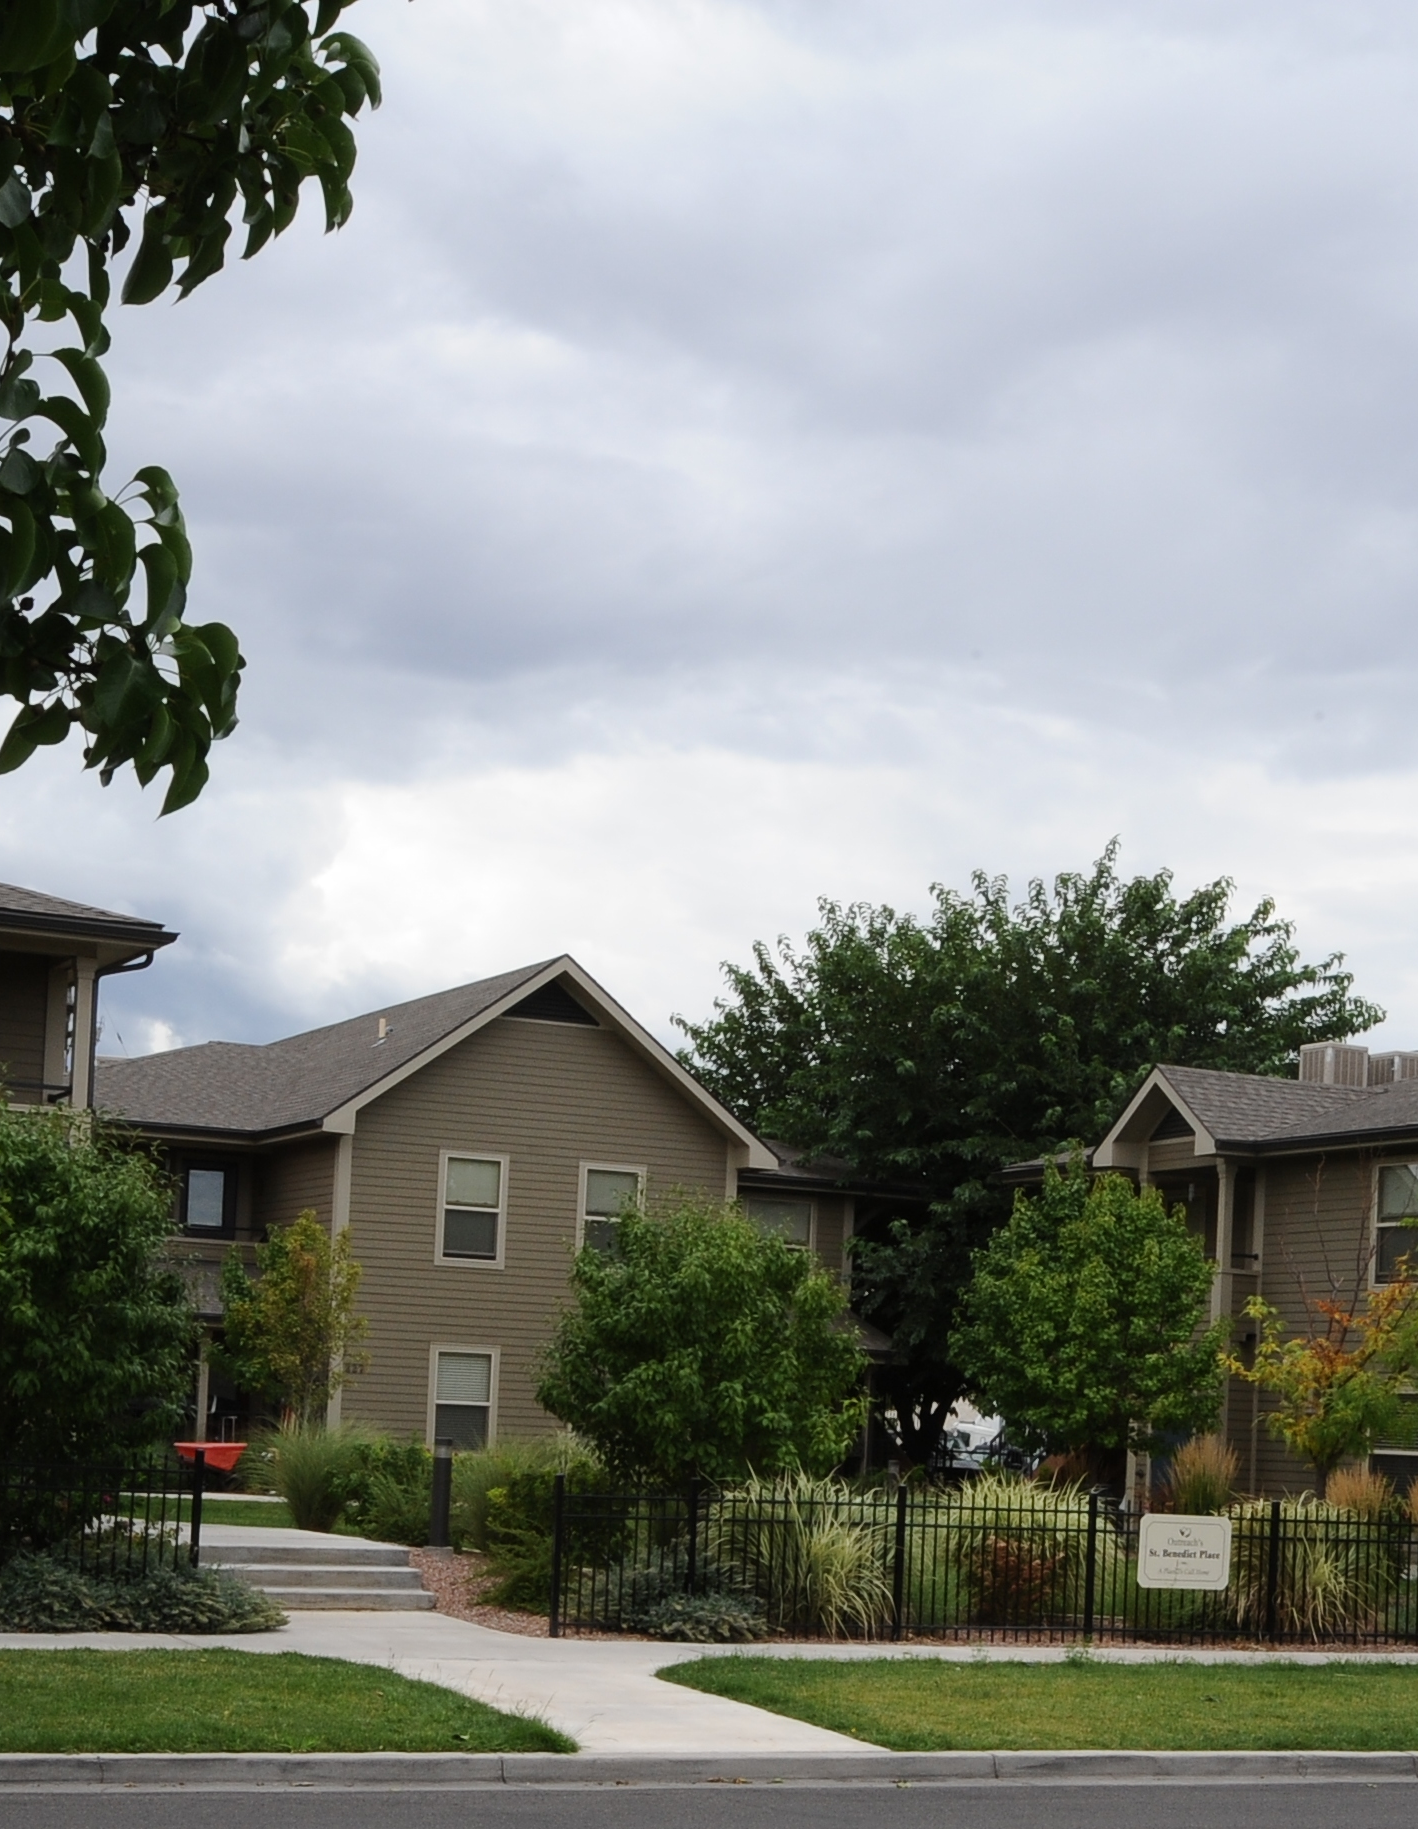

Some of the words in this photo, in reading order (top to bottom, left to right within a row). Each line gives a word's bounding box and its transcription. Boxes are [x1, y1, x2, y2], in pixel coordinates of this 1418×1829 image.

[1149, 1548, 1160, 1557] St.
[1162, 1548, 1197, 1559] Benedict
[1199, 1550, 1221, 1559] Place
